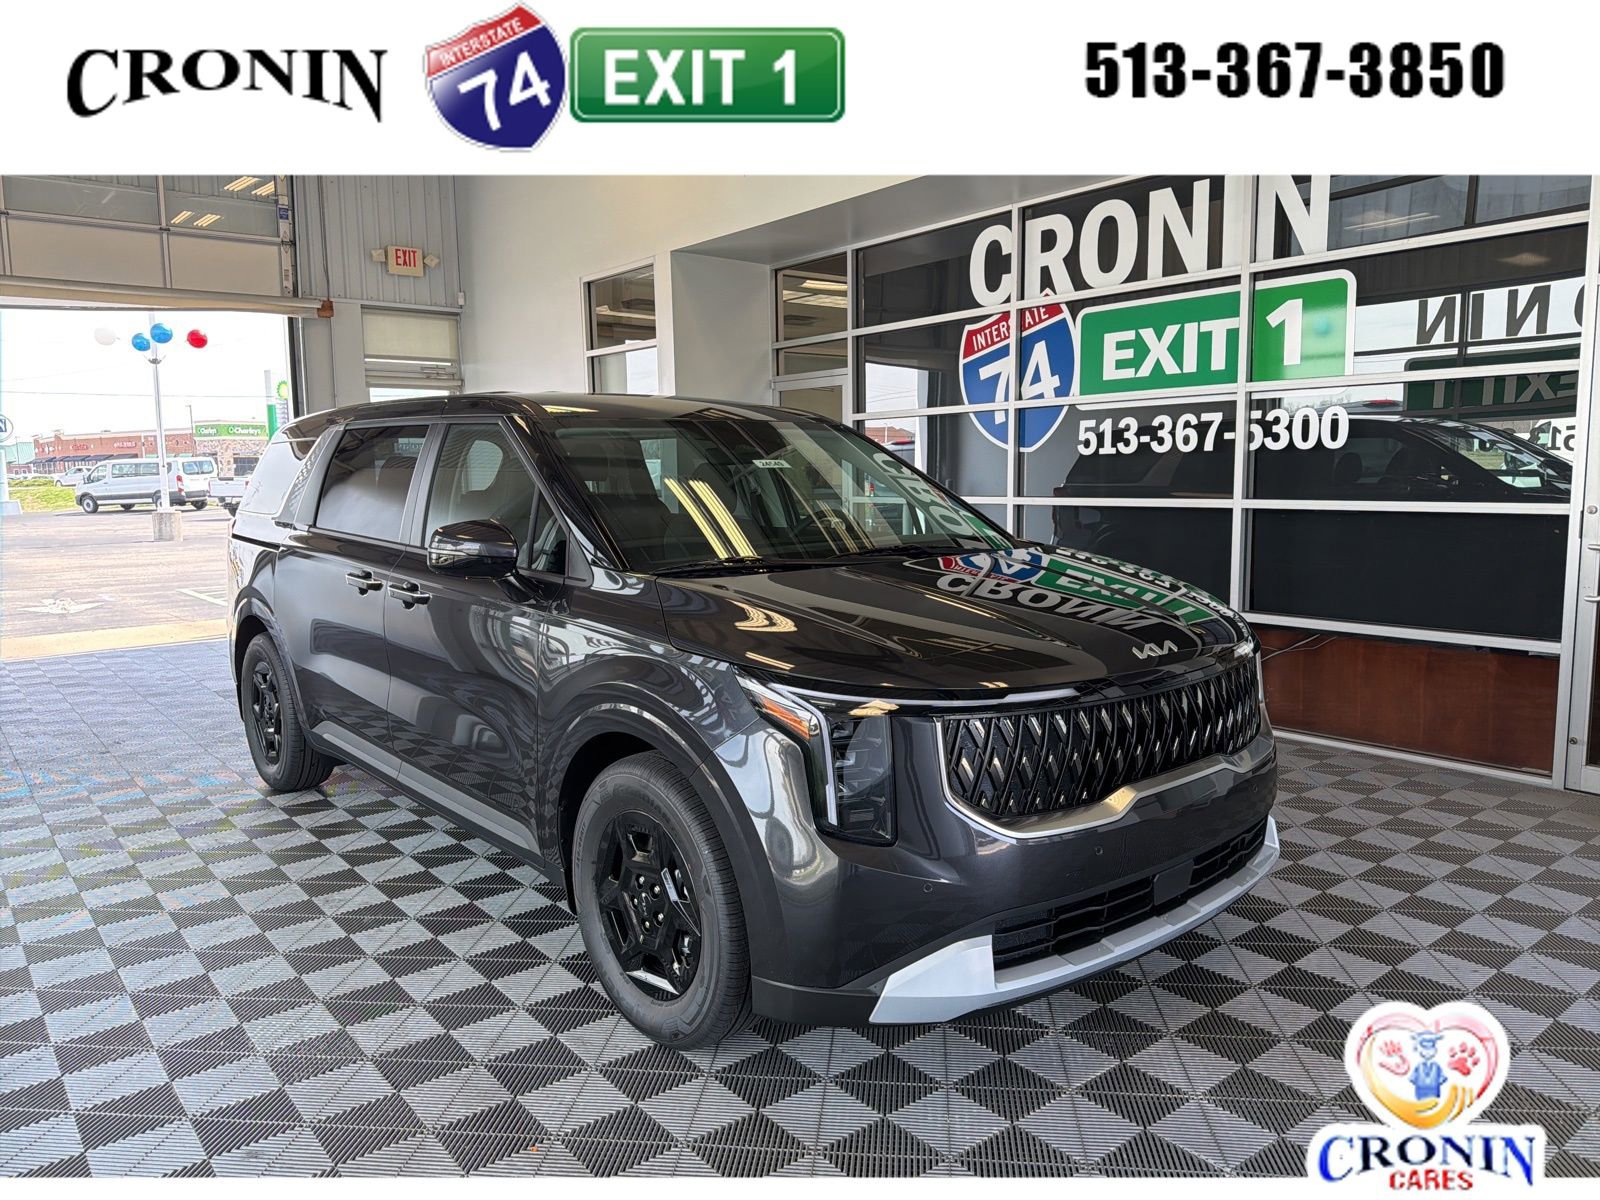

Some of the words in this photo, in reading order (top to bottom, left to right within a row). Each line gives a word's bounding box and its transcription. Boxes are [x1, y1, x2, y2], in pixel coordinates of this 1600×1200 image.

[395, 248, 417, 268] EXIT
[969, 174, 1331, 307] CRONIN
[972, 306, 1049, 352] INTERATE
[1103, 317, 1240, 381] EXIT
[1266, 298, 1303, 366] 1
[978, 340, 1061, 425] 74
